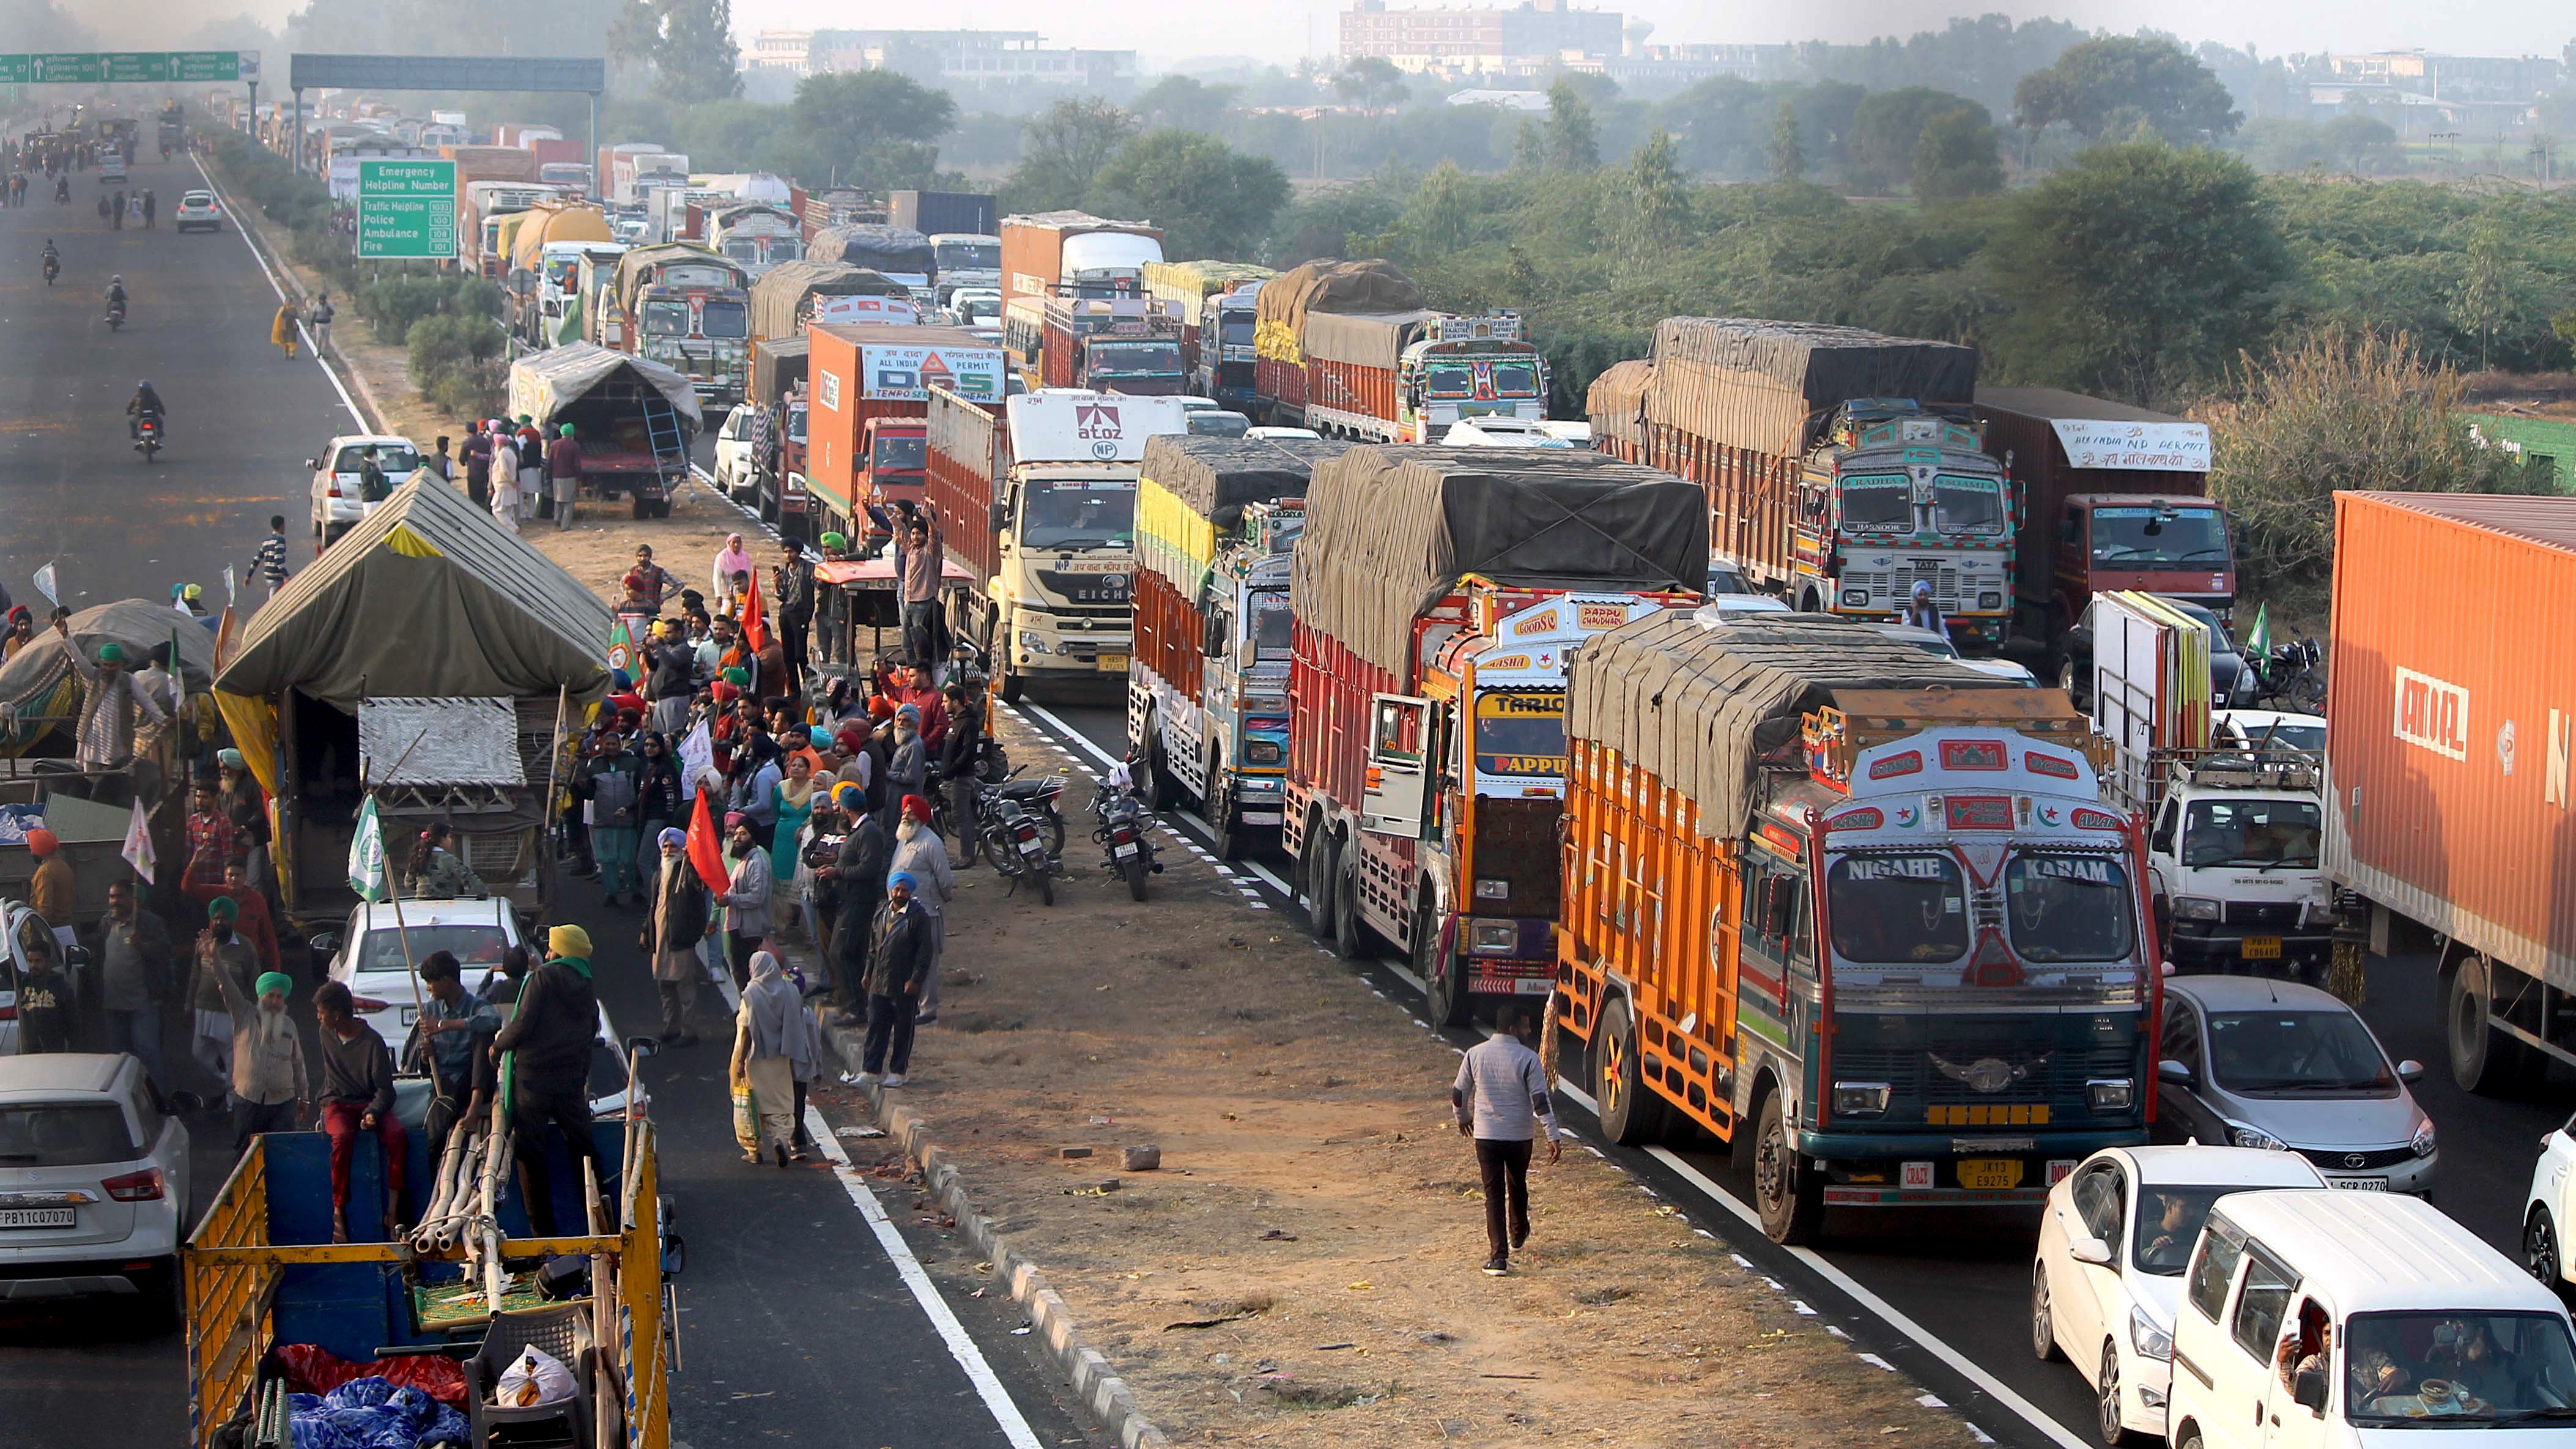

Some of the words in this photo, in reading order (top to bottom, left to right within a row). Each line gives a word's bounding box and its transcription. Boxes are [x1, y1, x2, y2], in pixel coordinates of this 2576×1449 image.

[379, 166, 435, 178] Emergency
[365, 181, 405, 191] Helpline
[411, 181, 450, 190] Number
[364, 202, 390, 211] Traffic
[391, 202, 424, 213] Helpline
[363, 215, 394, 224] Police
[364, 229, 419, 238] Ambulance
[363, 241, 382, 251] Fire
[876, 389, 910, 398] TEMPO
[1096, 444, 1114, 455] NP
[2158, 442, 2205, 451] PERMIT
[1945, 479, 1985, 489] SOAMI
[1914, 561, 1939, 570] TATA
[1583, 607, 1621, 618] PAPPU
[1519, 615, 1547, 634] GOODS
[1582, 616, 1623, 626] CHAUDHARY
[1494, 757, 1567, 773] PAPPU
[2078, 812, 2117, 828] ALLAH
[1846, 858, 1941, 880] NIGAHE
[2024, 858, 2110, 882] KARAM
[1906, 1166, 1928, 1185] CRAZY
[1977, 1174, 2009, 1187] E9275
